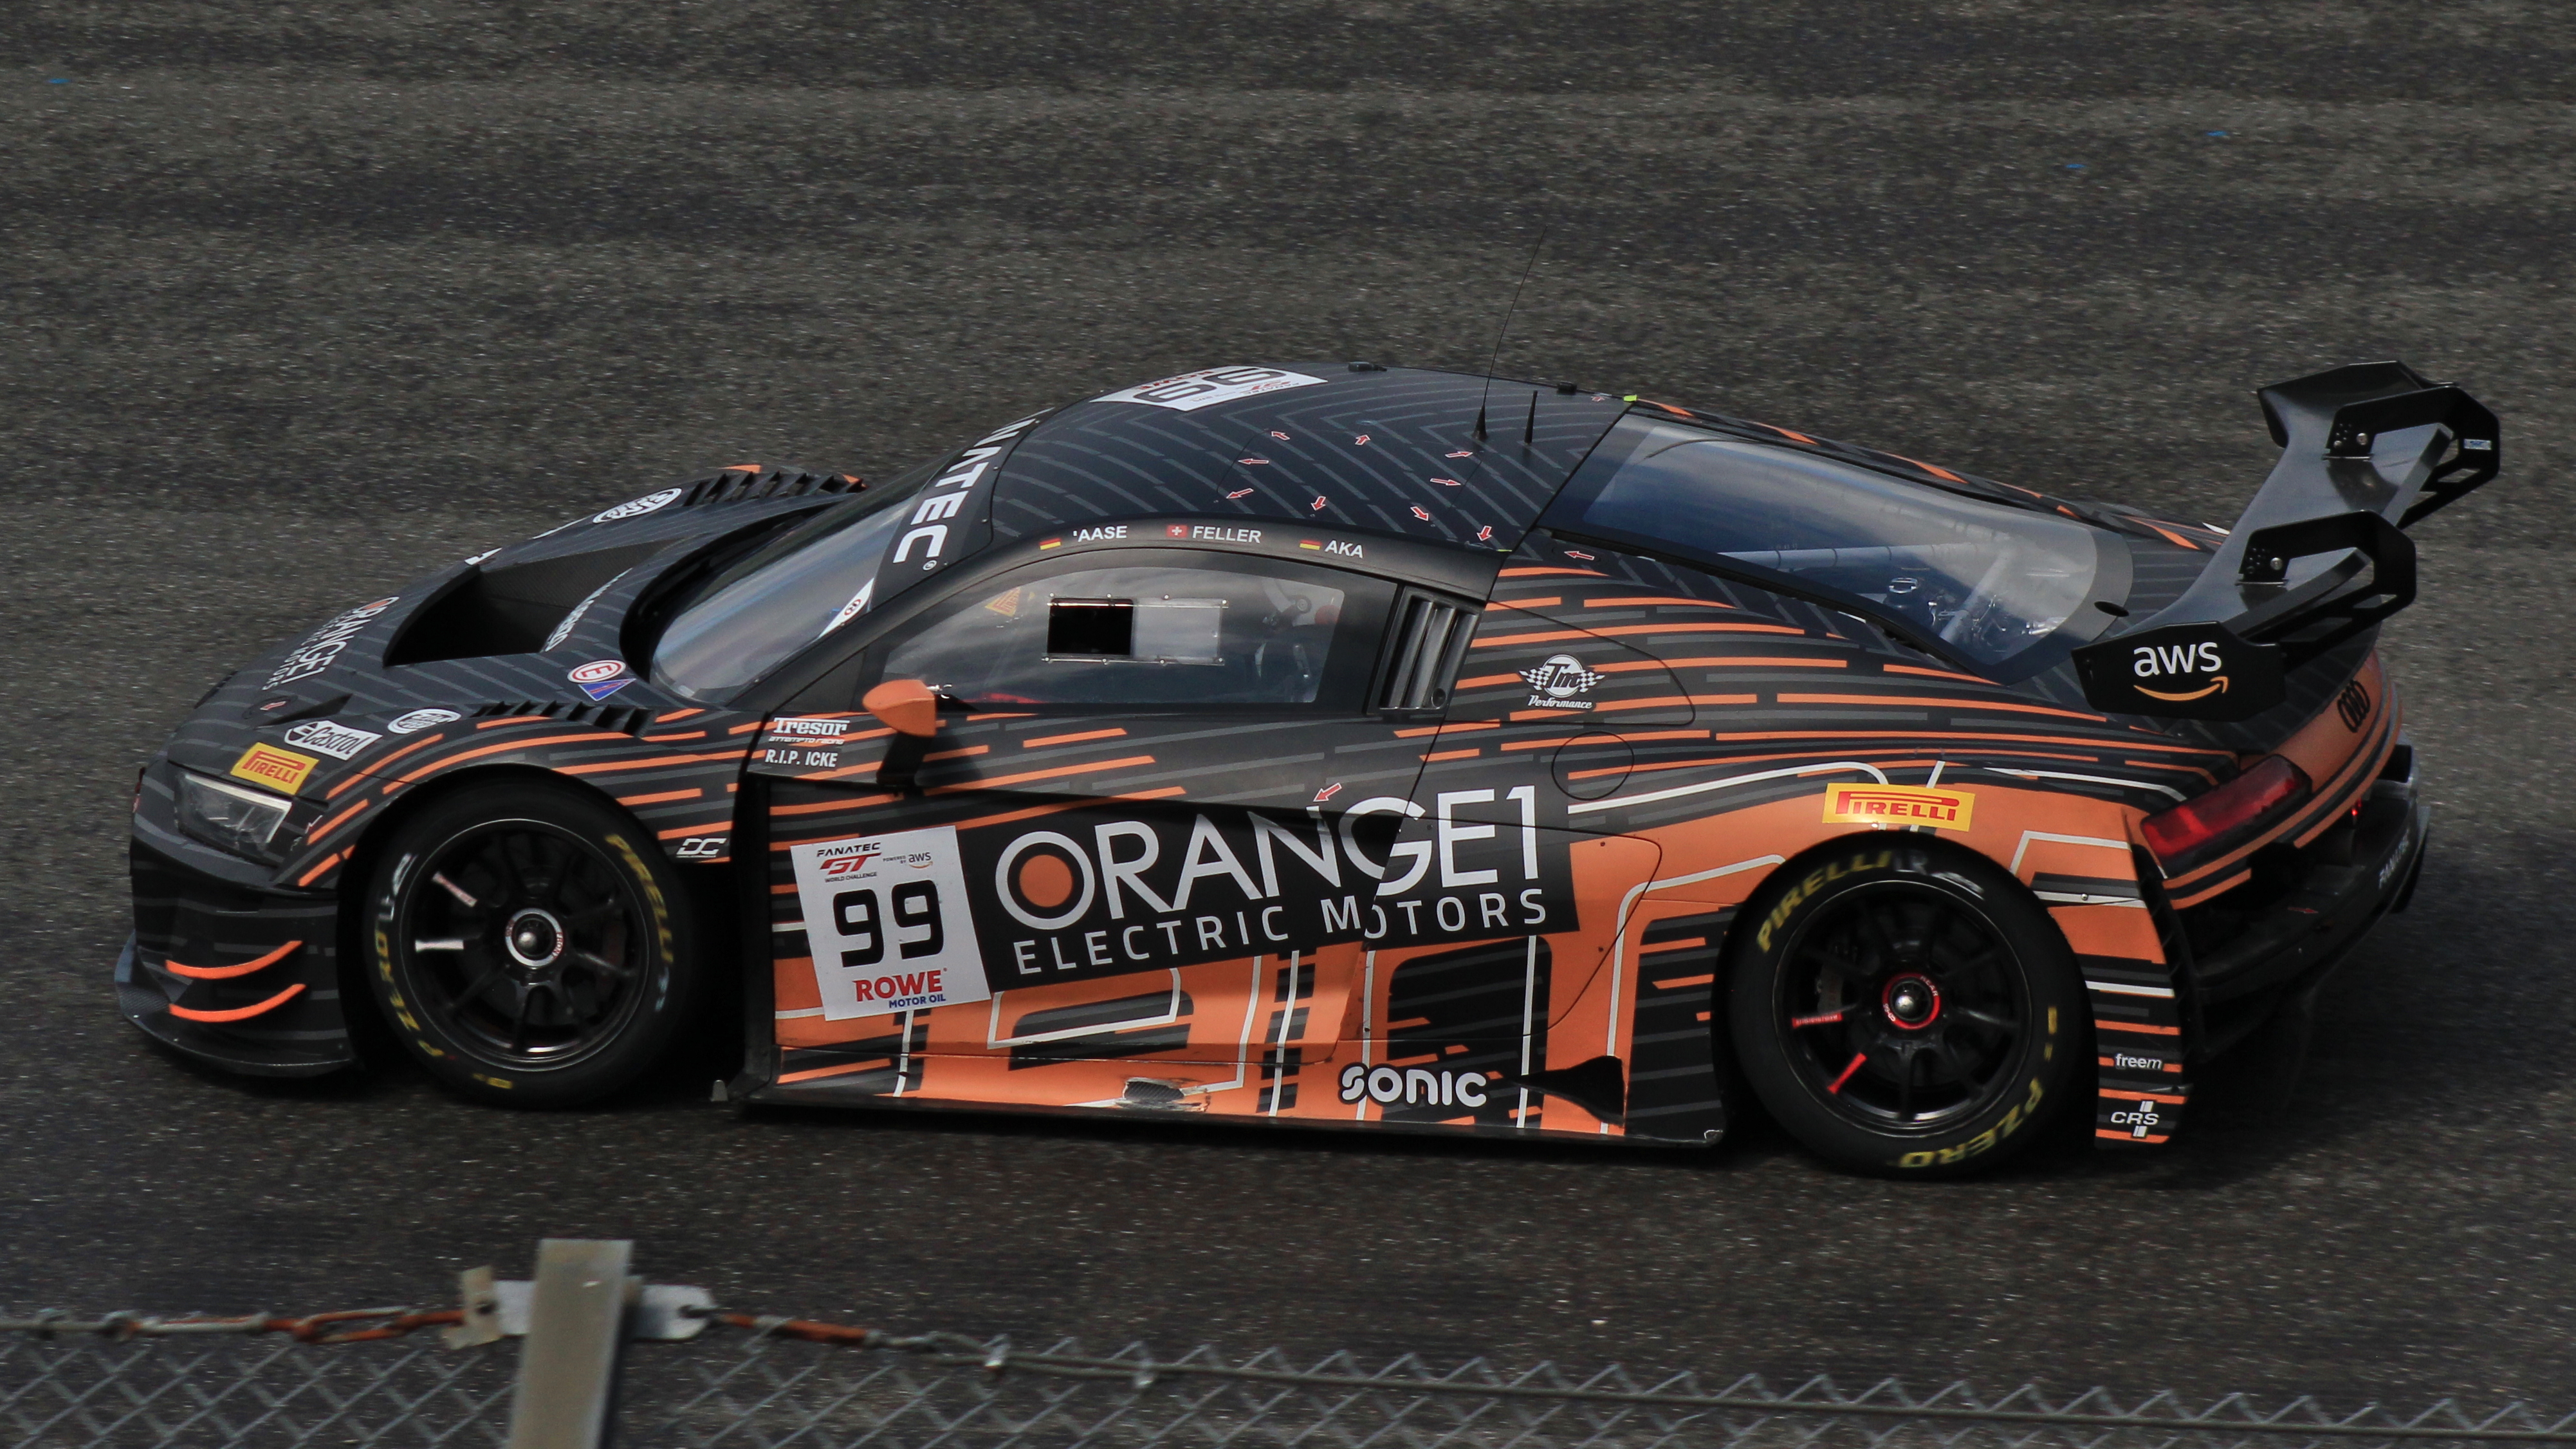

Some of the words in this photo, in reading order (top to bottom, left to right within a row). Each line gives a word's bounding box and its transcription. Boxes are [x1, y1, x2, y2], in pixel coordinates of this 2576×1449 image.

[1074, 526, 1128, 542] AASE
[1192, 526, 1262, 544] FELLER
[1325, 539, 1364, 558] AKA
[2133, 641, 2222, 678] aws
[1527, 694, 1593, 709] Performance
[773, 717, 851, 736] Tresor
[302, 726, 372, 755] Castrol
[242, 750, 306, 784] PIRELLI
[765, 749, 800, 765] R.I.P.
[805, 751, 838, 768] ICKE
[1836, 791, 1961, 822] PIRELLI
[816, 842, 881, 858] FANATEC
[908, 851, 932, 863] aws
[995, 784, 1539, 930] ORANGE1
[845, 871, 878, 880] CHALLENGE
[1757, 850, 1892, 953] PIRELLI
[833, 880, 944, 968] 99
[1013, 906, 1288, 975] ELECTRIC
[1320, 888, 1546, 939] MOTORS
[852, 969, 943, 1002] ROWE
[888, 996, 926, 1008] MOTOR
[928, 994, 947, 1004] OIL
[2115, 1053, 2162, 1069] freem
[2110, 1111, 2159, 1125] CRS
